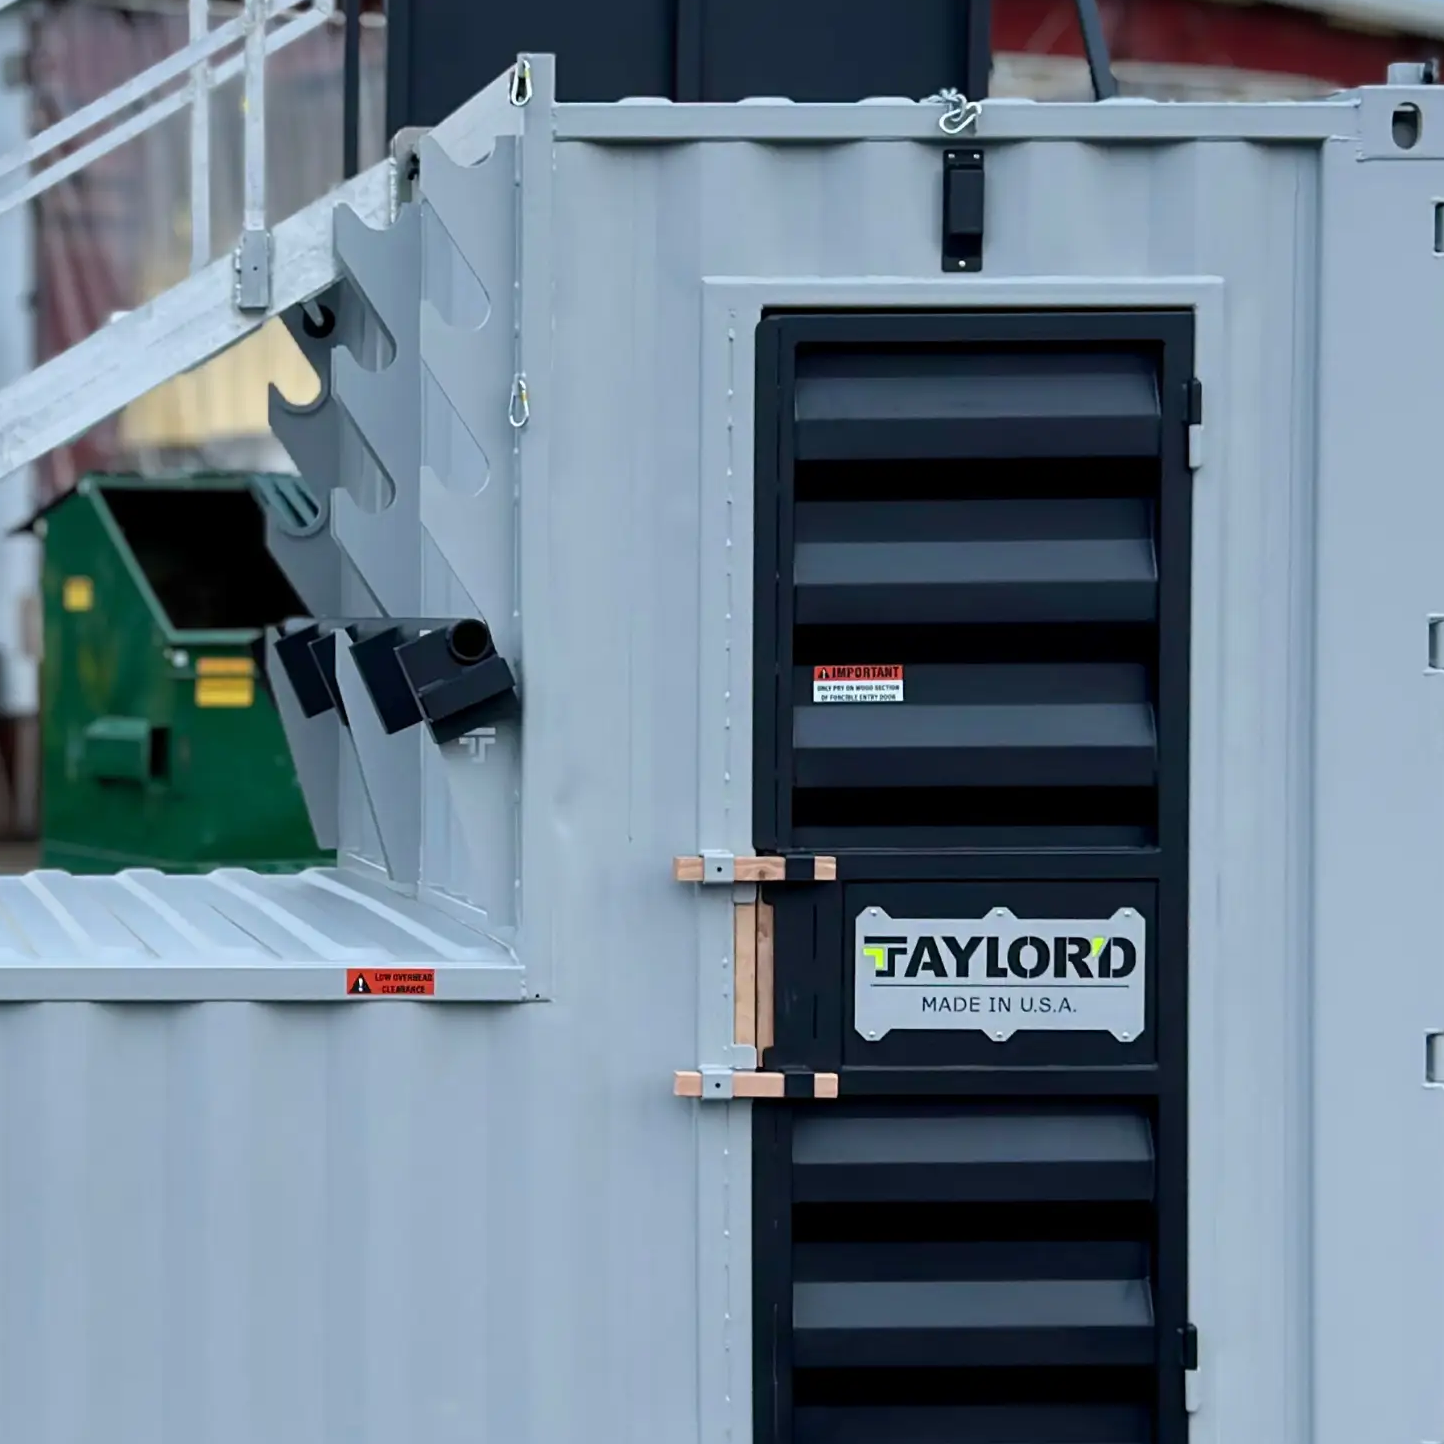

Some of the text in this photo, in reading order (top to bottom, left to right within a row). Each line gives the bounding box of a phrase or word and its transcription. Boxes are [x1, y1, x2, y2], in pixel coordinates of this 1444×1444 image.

[832, 666, 899, 678] IMPORTANT
[374, 972, 433, 982] LOW OVERHEAD
[382, 985, 426, 994] CLEARANCE
[921, 996, 1078, 1013] MADE IN U.S.A.
